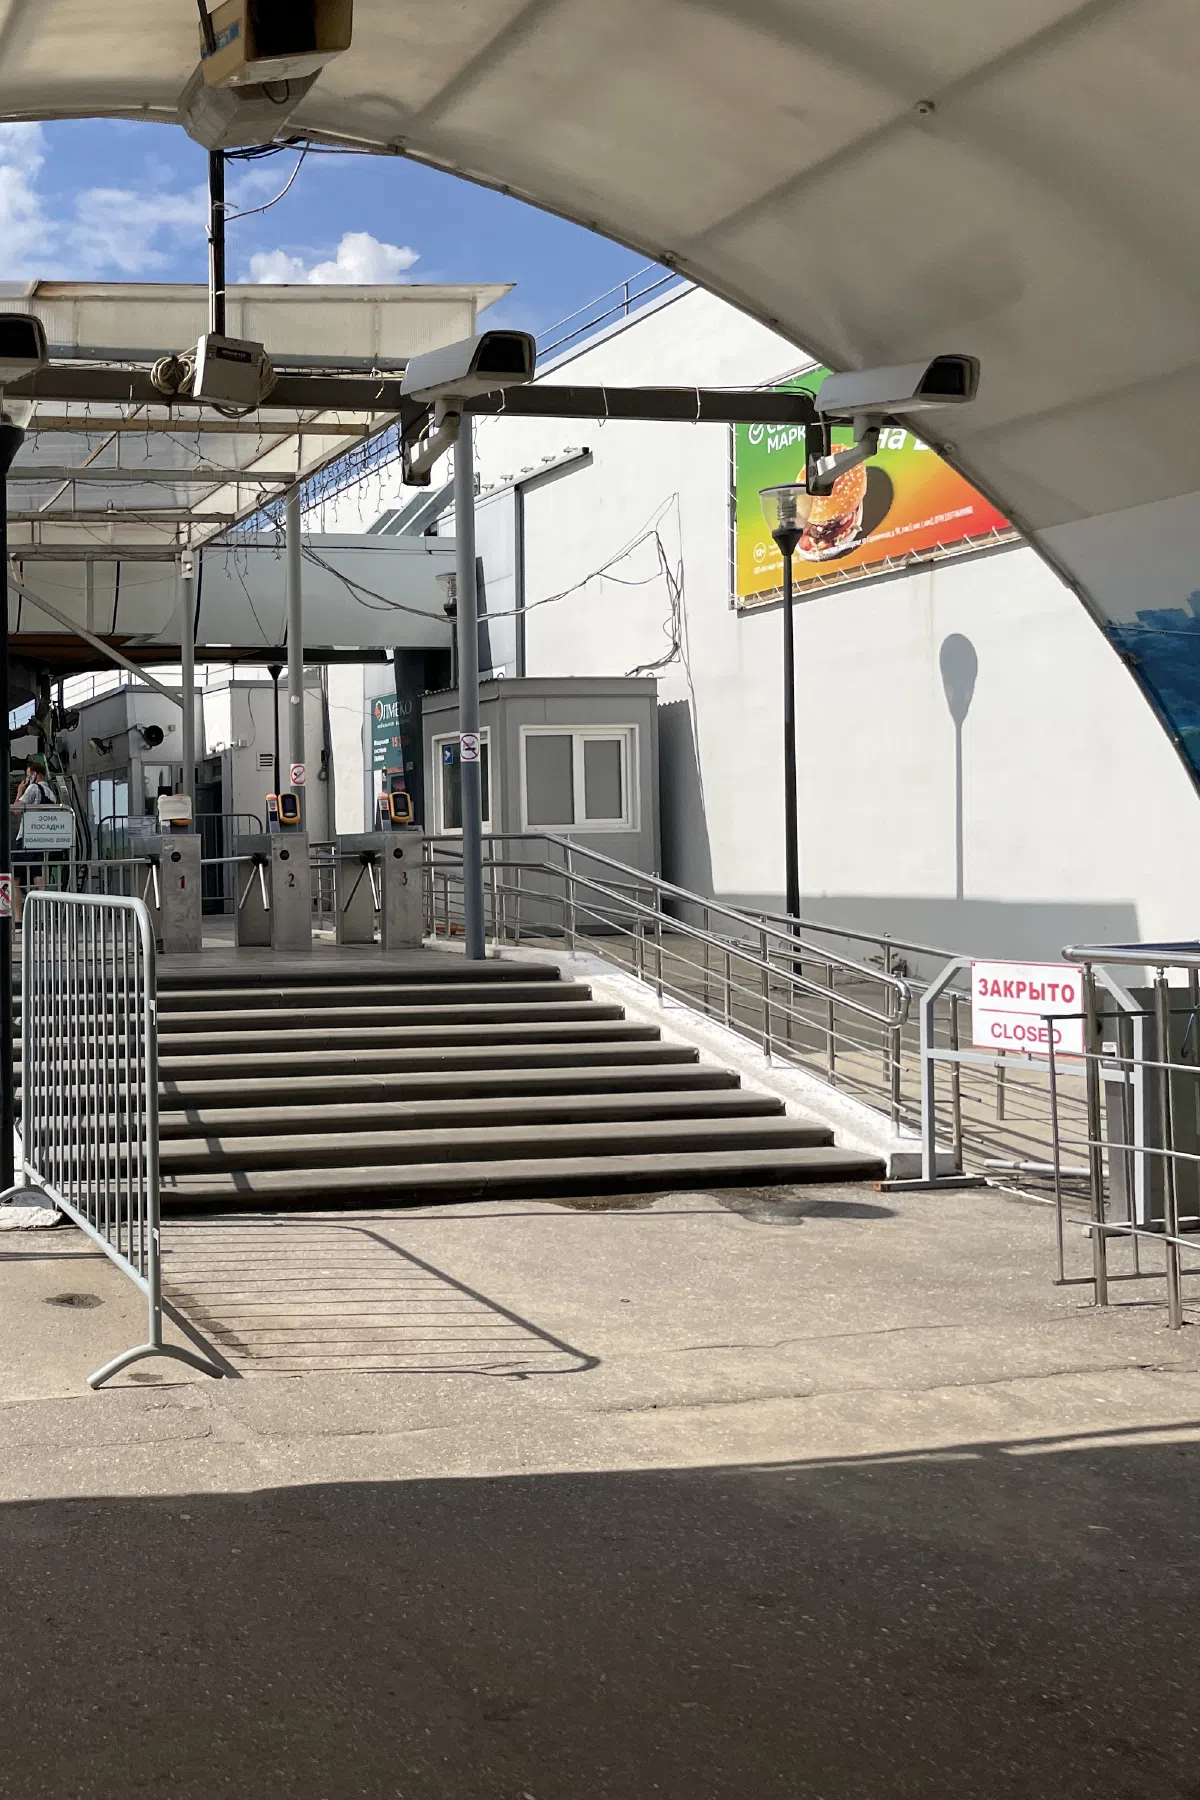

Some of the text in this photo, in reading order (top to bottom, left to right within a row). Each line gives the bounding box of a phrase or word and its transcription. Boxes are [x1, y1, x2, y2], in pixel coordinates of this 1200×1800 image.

[767, 425, 806, 454] МАРК
[31, 823, 65, 831] ПОСАДКИ
[178, 876, 186, 889] 1
[287, 873, 295, 888] 2
[400, 871, 408, 885] 3
[978, 977, 1075, 1003] ЗАКРЫТО
[990, 1022, 1062, 1045] CLOSED
